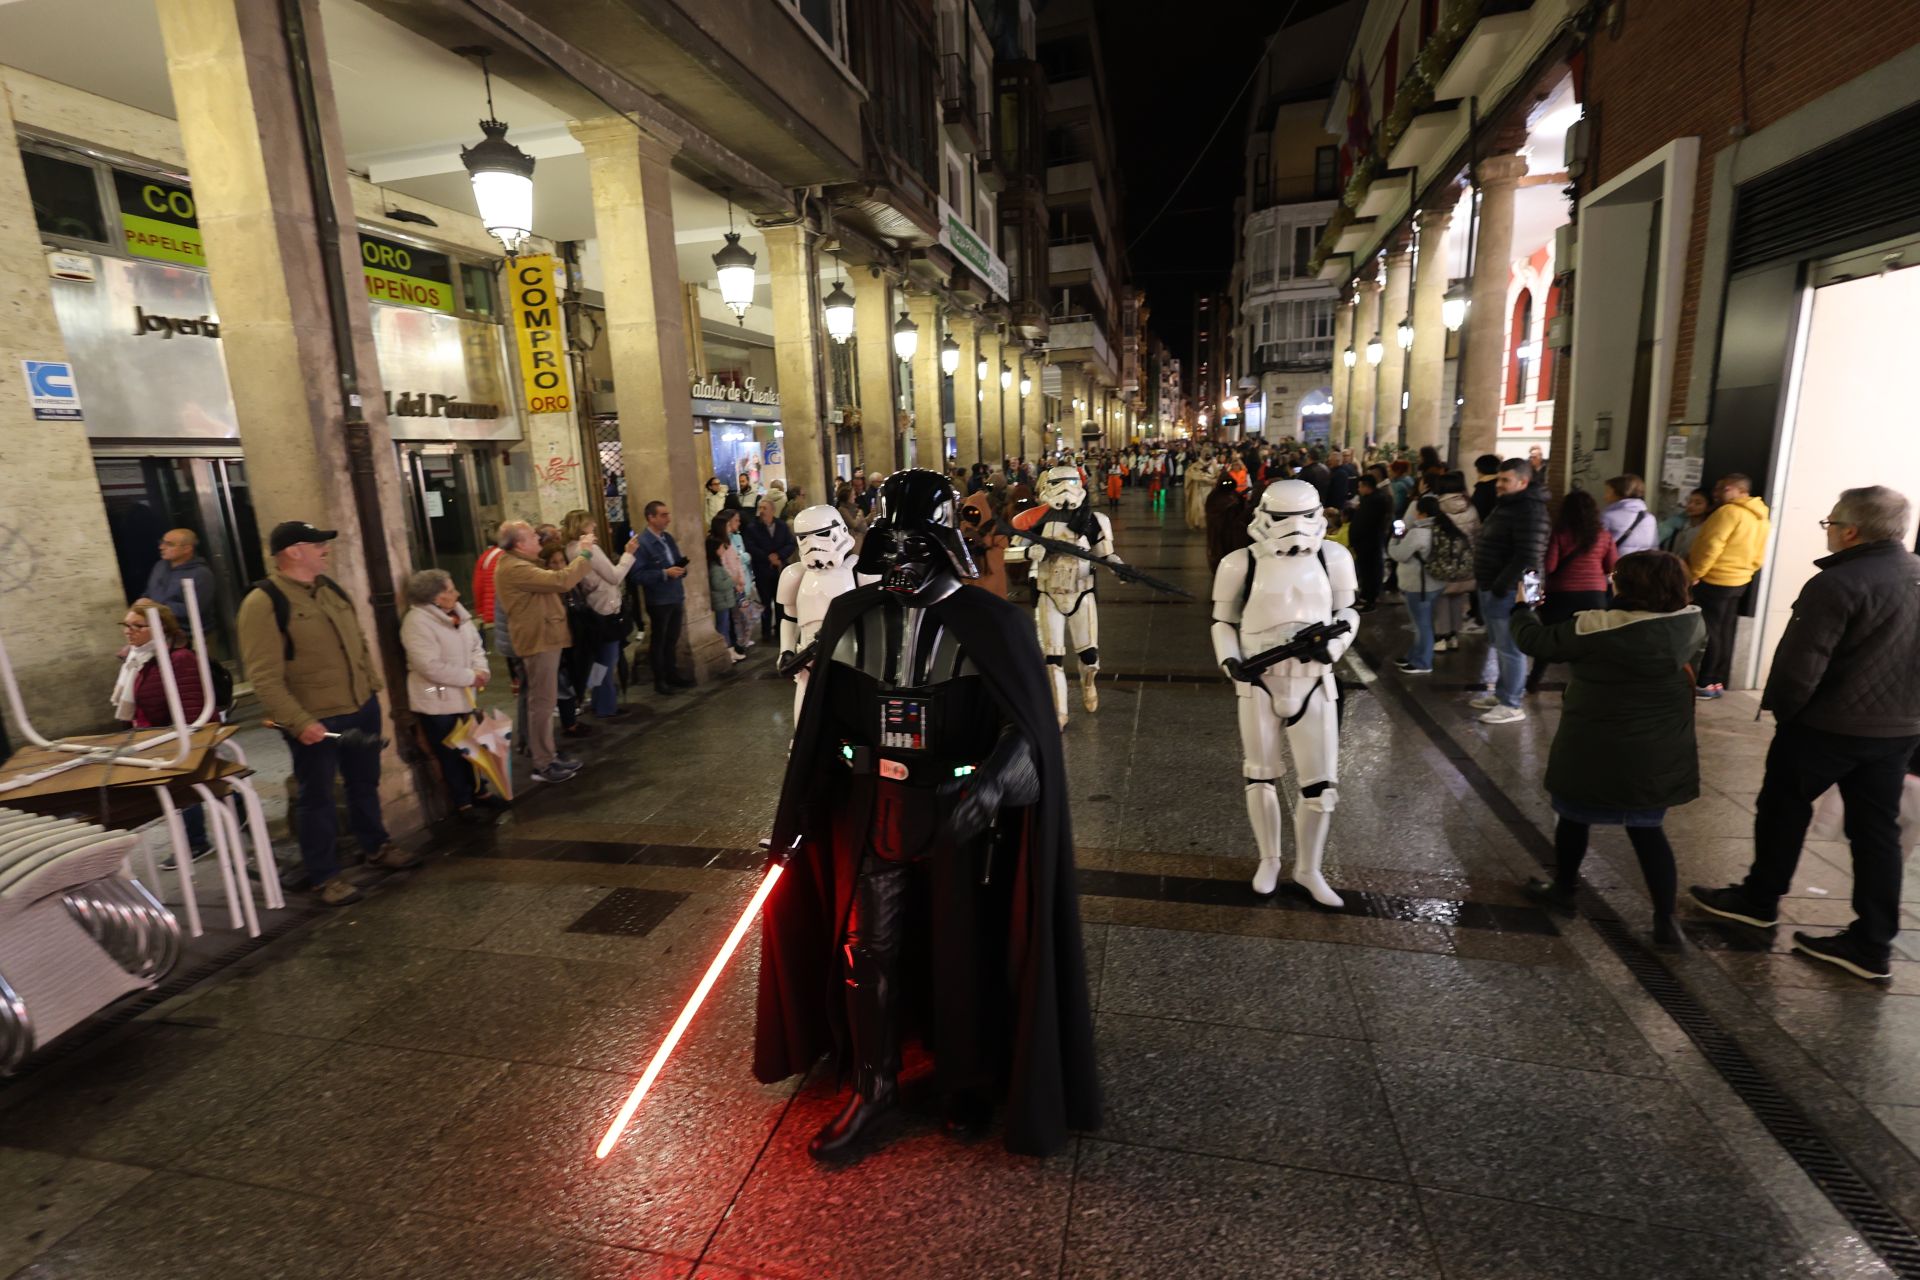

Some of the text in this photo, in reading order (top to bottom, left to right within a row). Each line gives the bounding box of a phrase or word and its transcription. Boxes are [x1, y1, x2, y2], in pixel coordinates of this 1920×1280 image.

[125, 229, 204, 257] PAPELET
[362, 241, 412, 271] ORO
[519, 267, 559, 389] COMPRO
[530, 395, 570, 411] ORO
[727, 381, 741, 402] de
